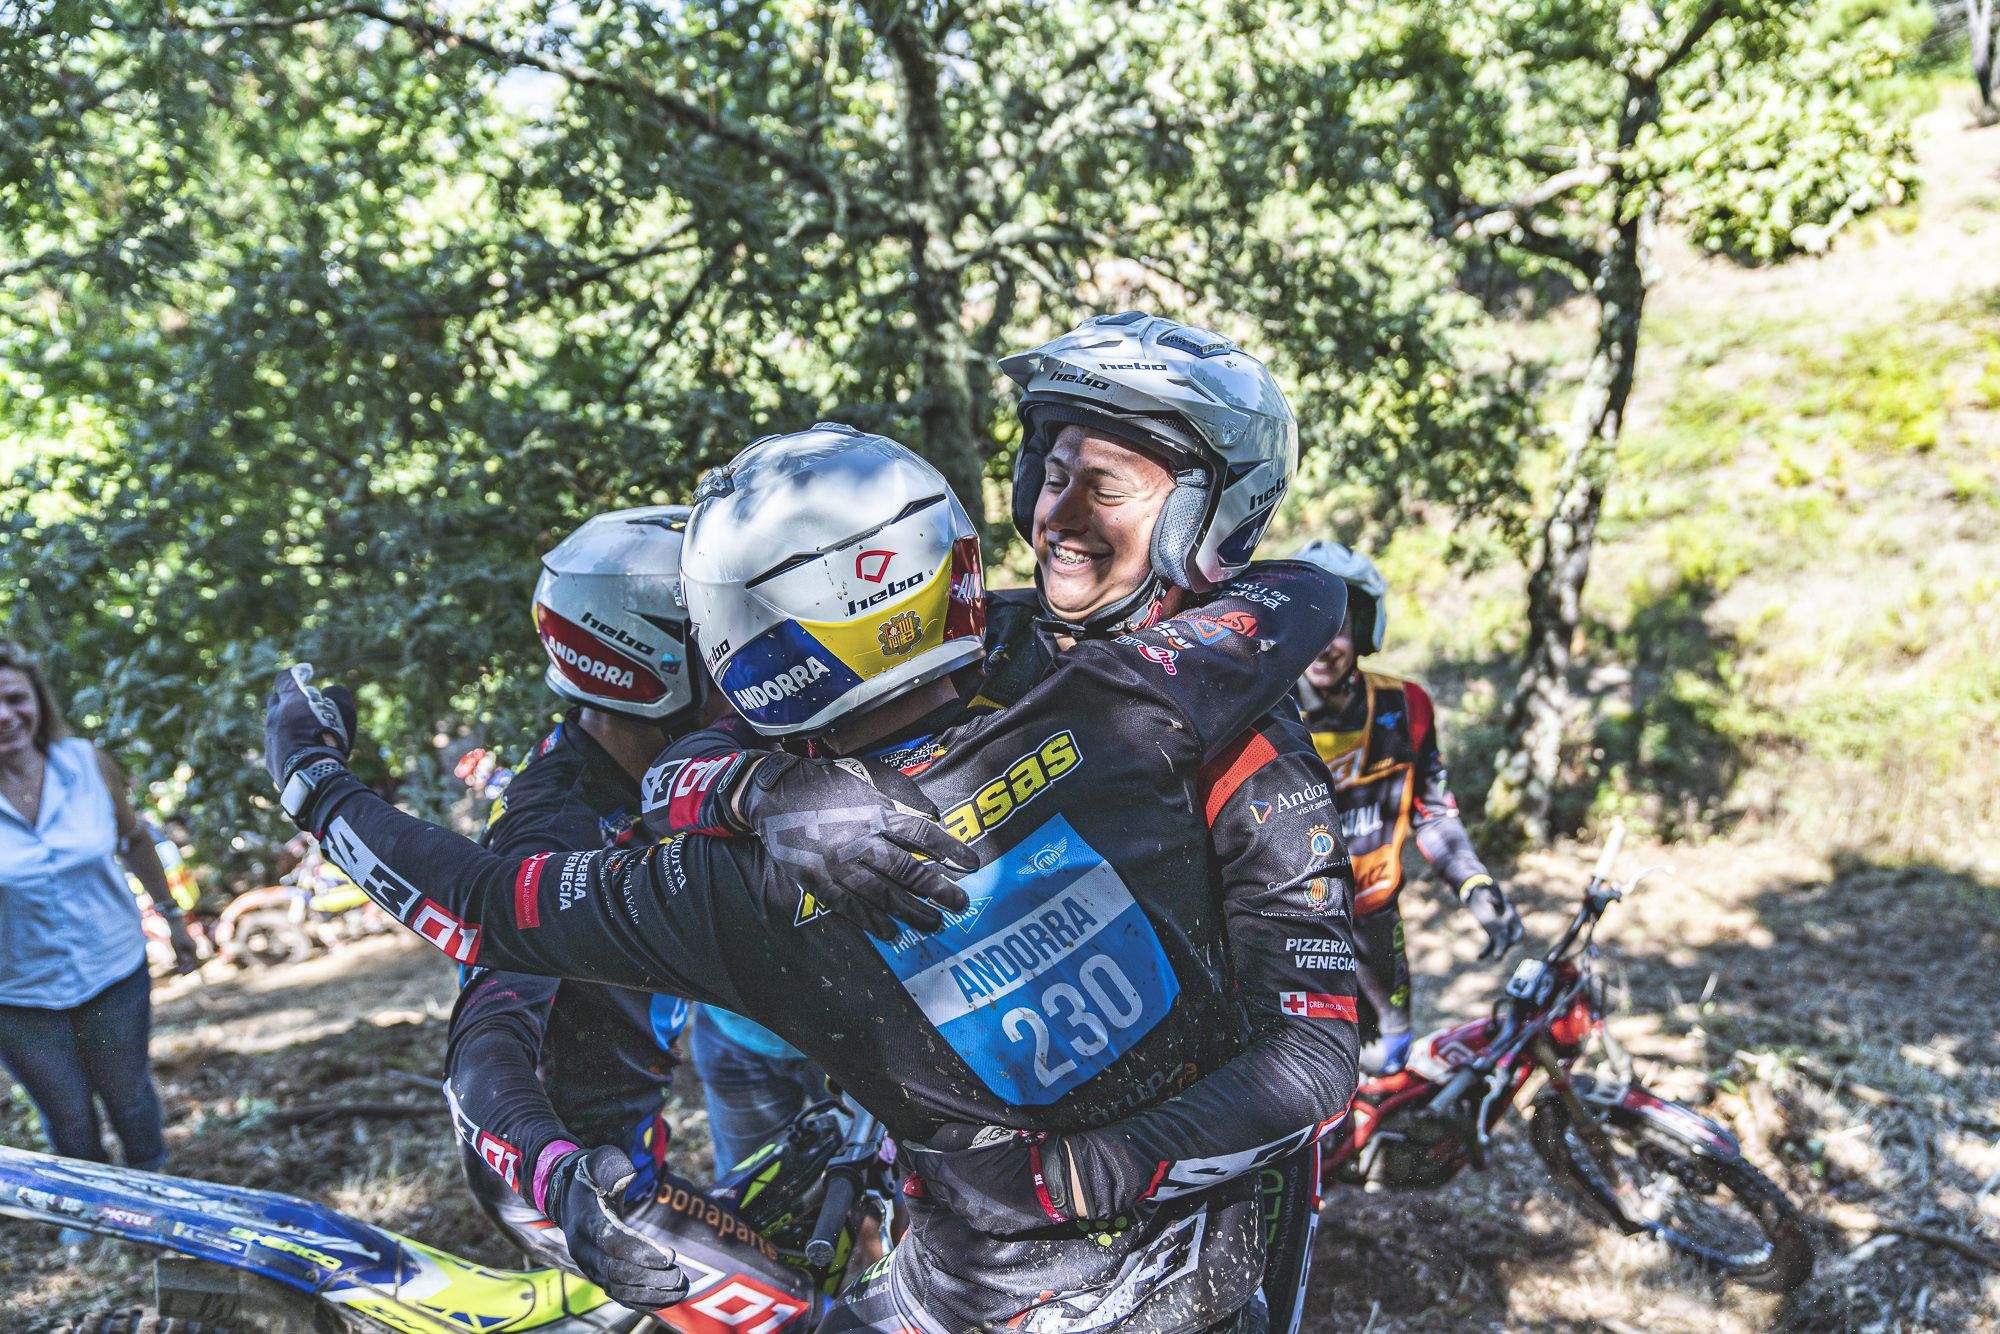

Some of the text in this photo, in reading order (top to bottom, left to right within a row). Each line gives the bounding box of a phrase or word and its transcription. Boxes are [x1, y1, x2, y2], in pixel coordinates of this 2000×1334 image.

[1049, 370, 1111, 391] hebo
[1099, 362, 1168, 371] hebo
[1250, 476, 1290, 511] heb
[848, 571, 924, 616] hebo
[581, 612, 656, 656] hebo
[549, 636, 634, 689] ANDORRA
[733, 656, 831, 711] ANDORRA
[943, 735, 1077, 843] asas
[949, 897, 1098, 1004] ANDORRA
[1285, 938, 1352, 955] PIZZERIA
[1295, 954, 1356, 972] VENECIA
[1002, 954, 1143, 1088] 230
